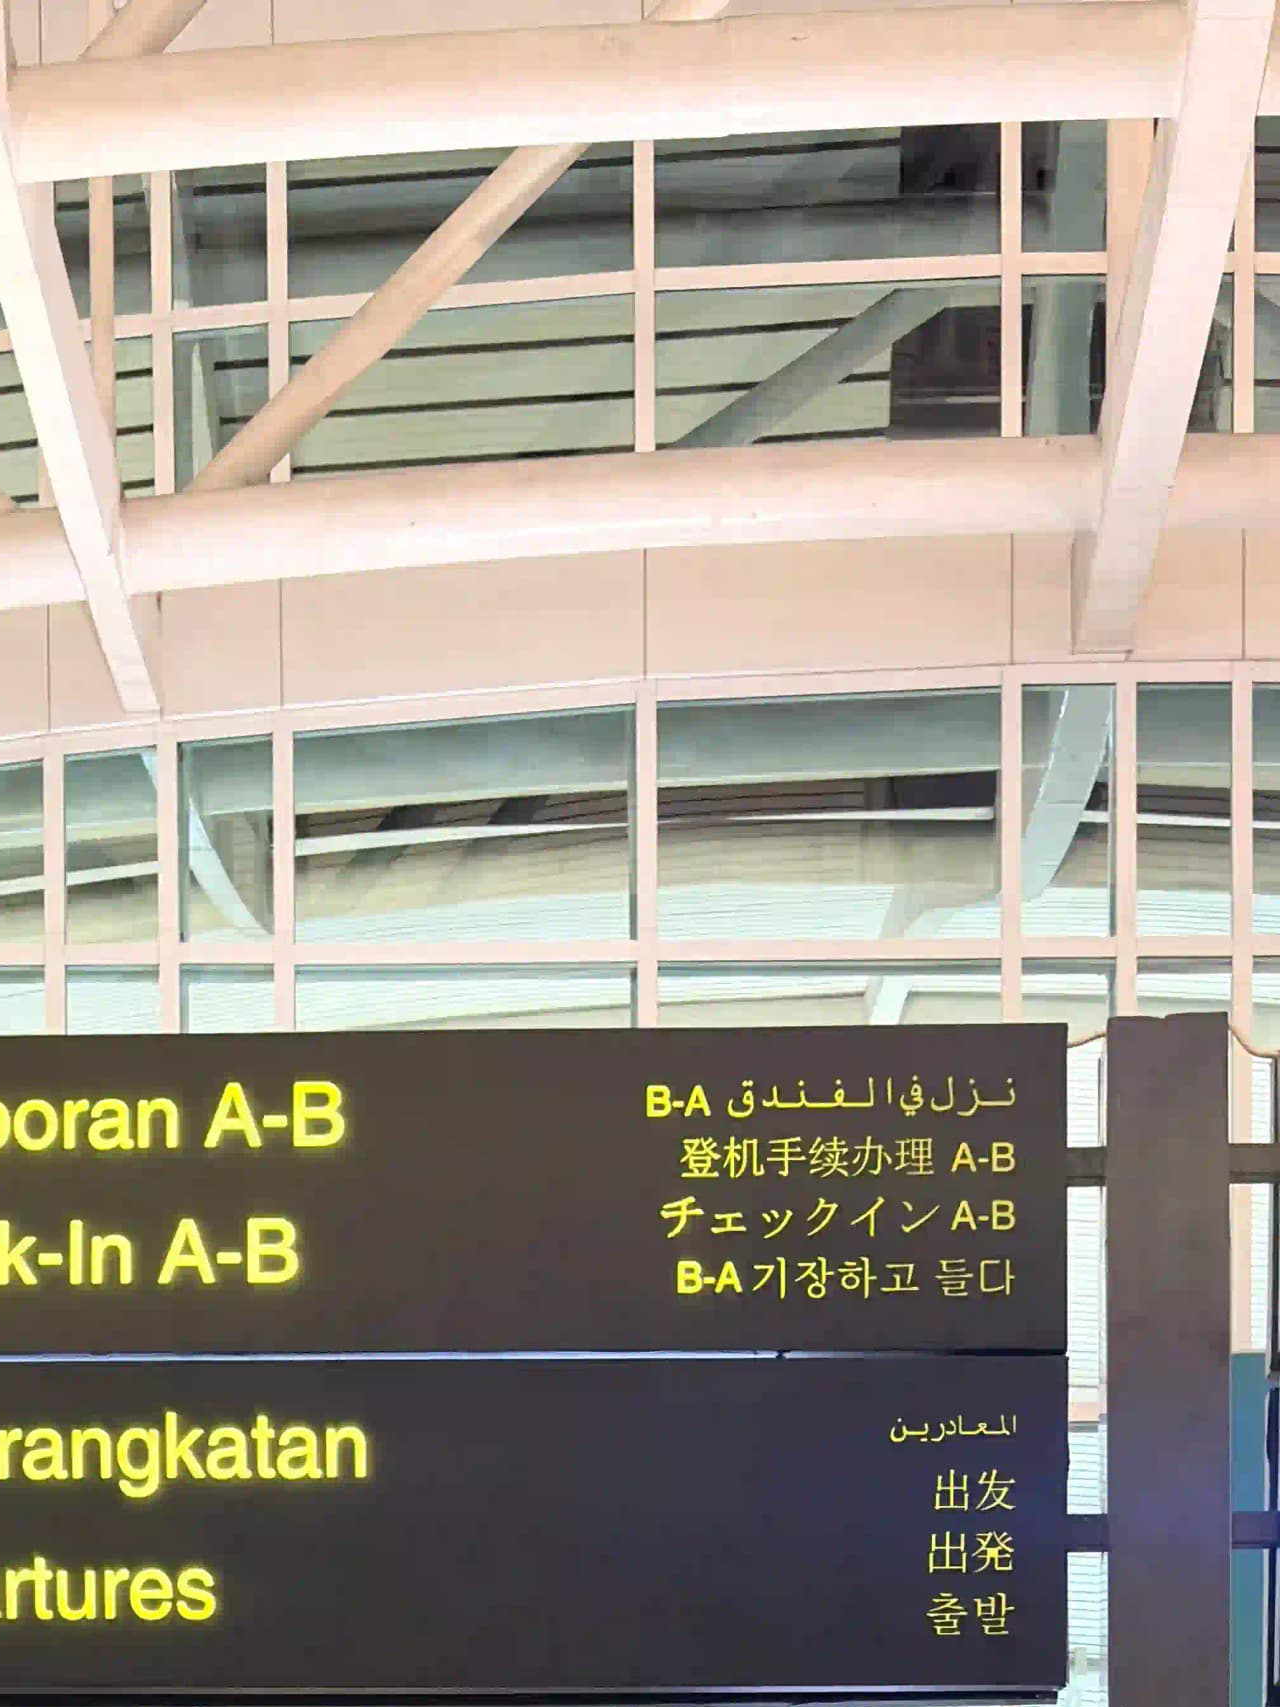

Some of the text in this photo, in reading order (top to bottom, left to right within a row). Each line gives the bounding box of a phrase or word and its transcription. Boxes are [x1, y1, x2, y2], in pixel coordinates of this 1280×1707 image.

[204, 1081, 348, 1149] A-B
[645, 1084, 712, 1118] B-A
[679, 1135, 1016, 1178] 登机手续办理 A-B
[659, 1194, 1016, 1240] チェックイン A-B
[156, 1216, 301, 1285] A-B
[675, 1256, 1016, 1300] B-A 기장하고 들다
[933, 1468, 1017, 1512] 出发
[927, 1529, 1016, 1574] 出発
[925, 1591, 1016, 1637] 출발
